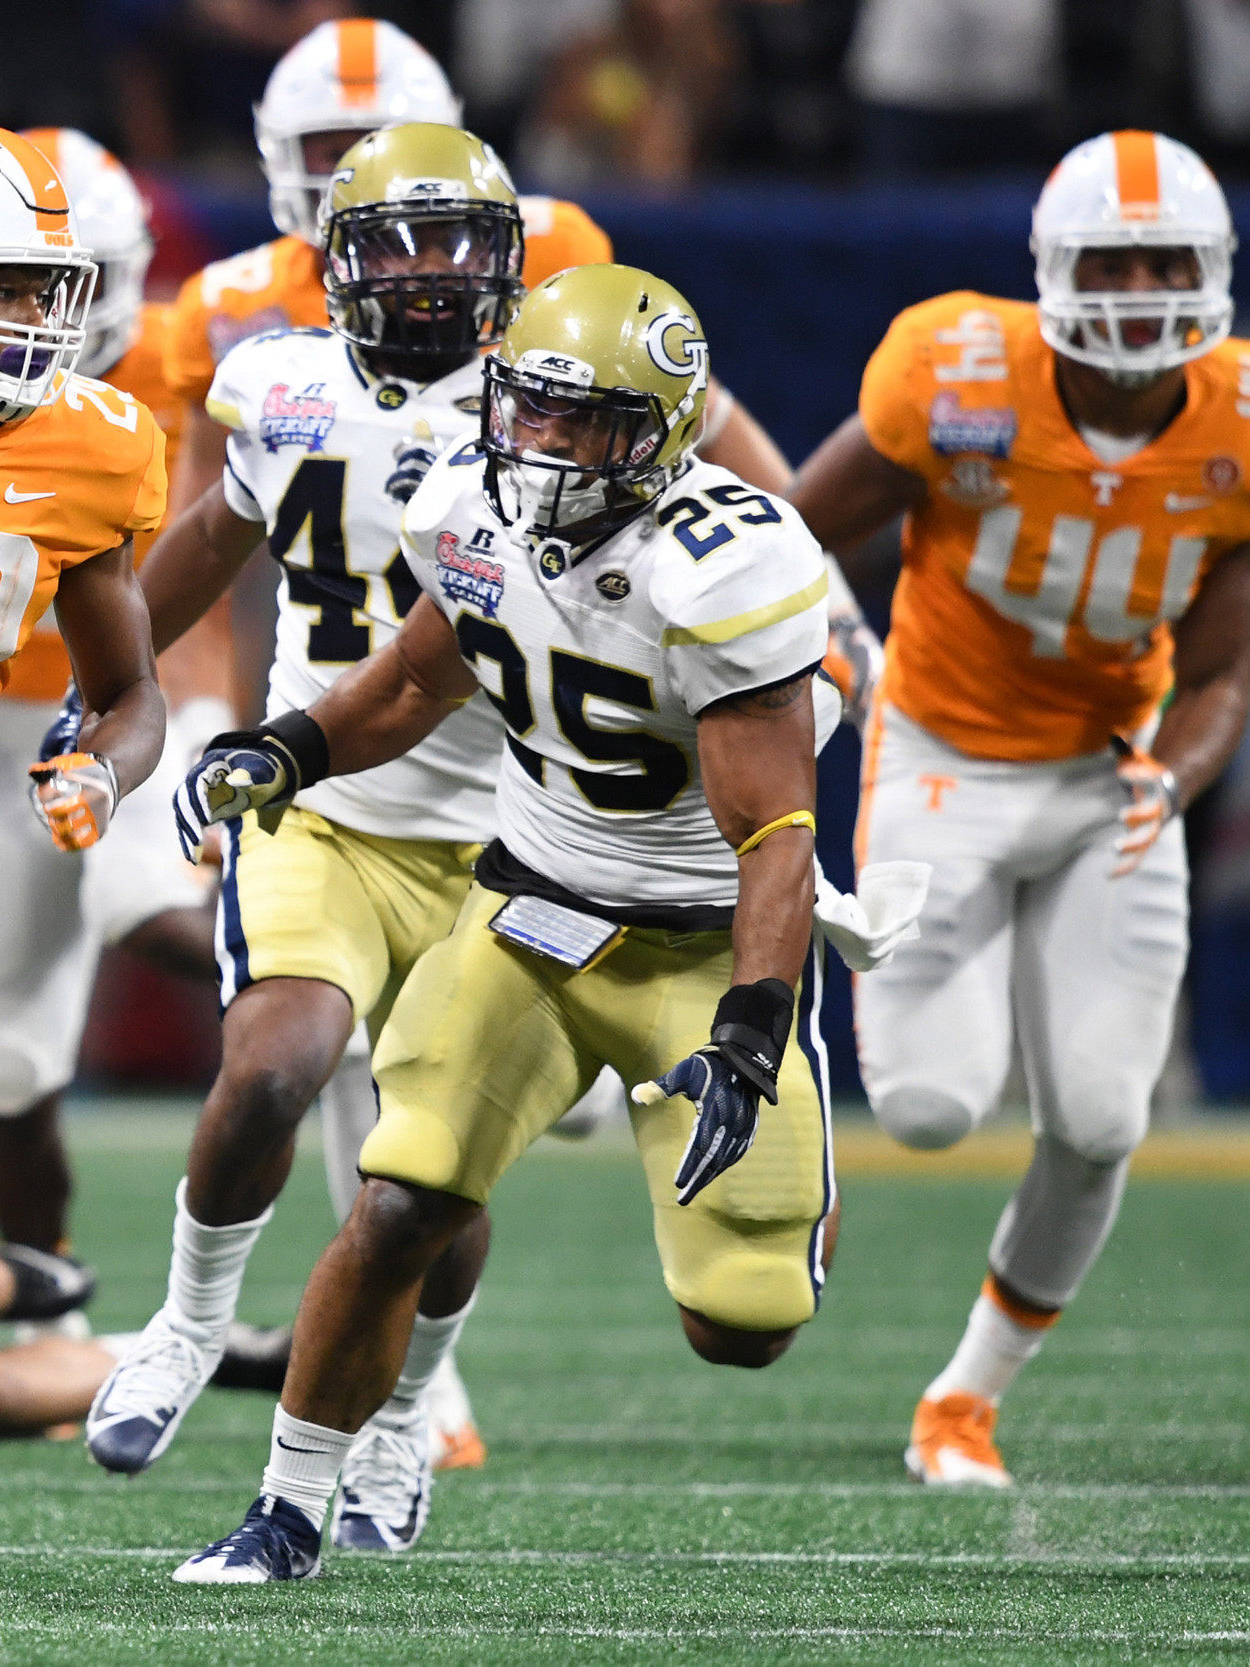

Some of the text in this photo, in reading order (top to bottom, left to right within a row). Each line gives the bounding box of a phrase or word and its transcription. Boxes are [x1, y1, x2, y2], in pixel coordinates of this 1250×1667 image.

[45, 233, 74, 247] VOLS
[539, 356, 576, 372] ACC
[471, 528, 495, 548] R
[657, 484, 783, 563] 25
[965, 506, 1207, 659] 44
[453, 612, 691, 814] 25
